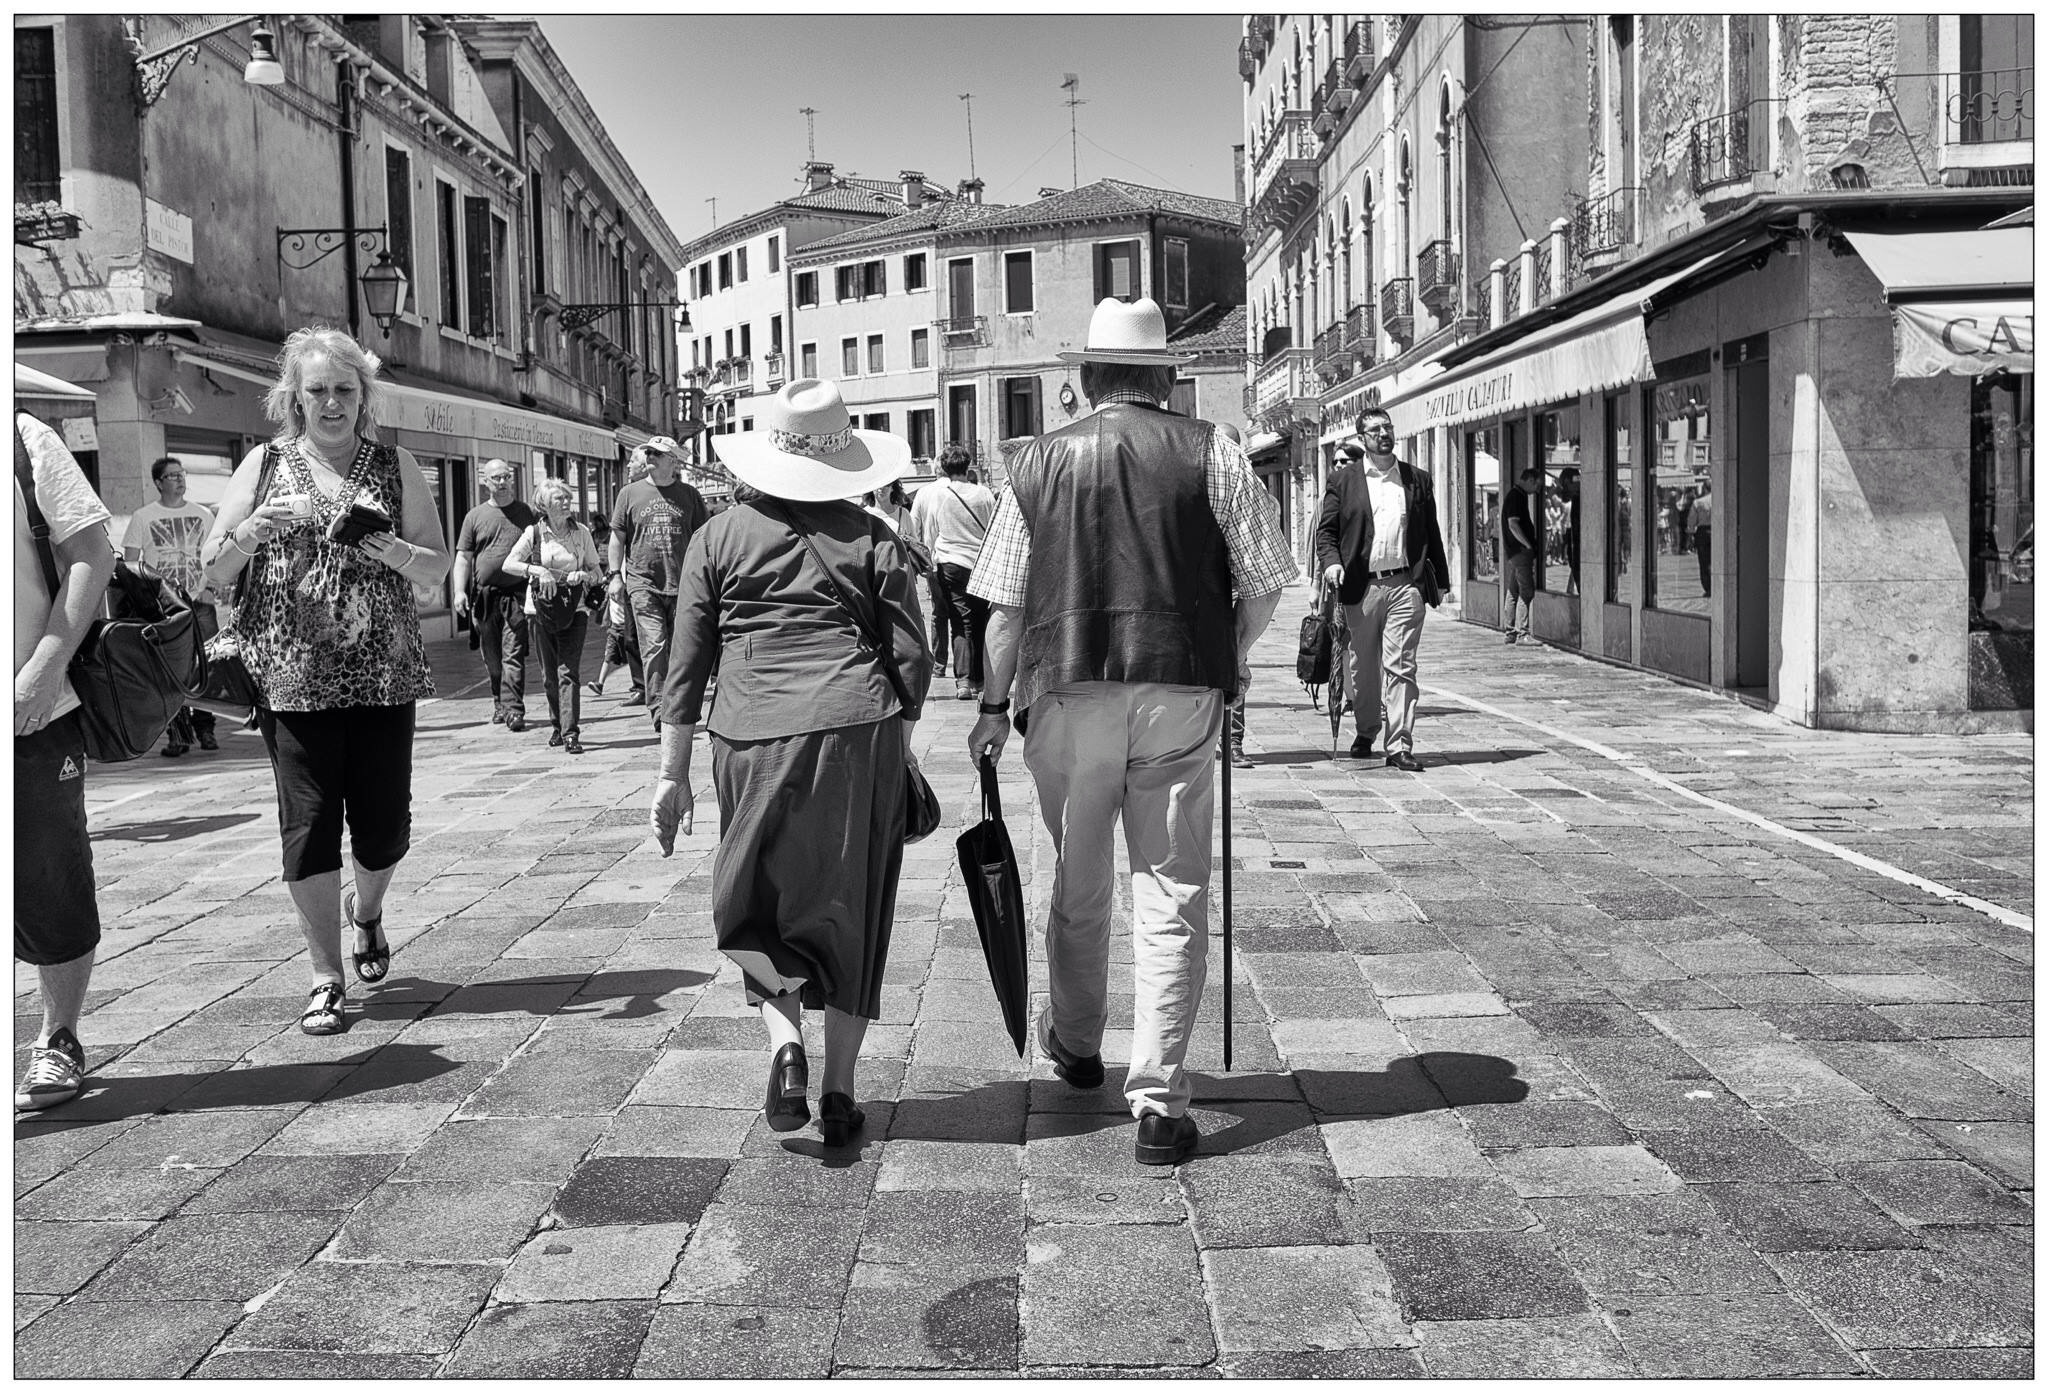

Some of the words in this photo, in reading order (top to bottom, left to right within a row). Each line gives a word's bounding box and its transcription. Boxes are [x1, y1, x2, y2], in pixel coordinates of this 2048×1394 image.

[1942, 315, 2034, 355] CA
[425, 403, 454, 432] Nbile
[662, 526, 682, 536] FREE
